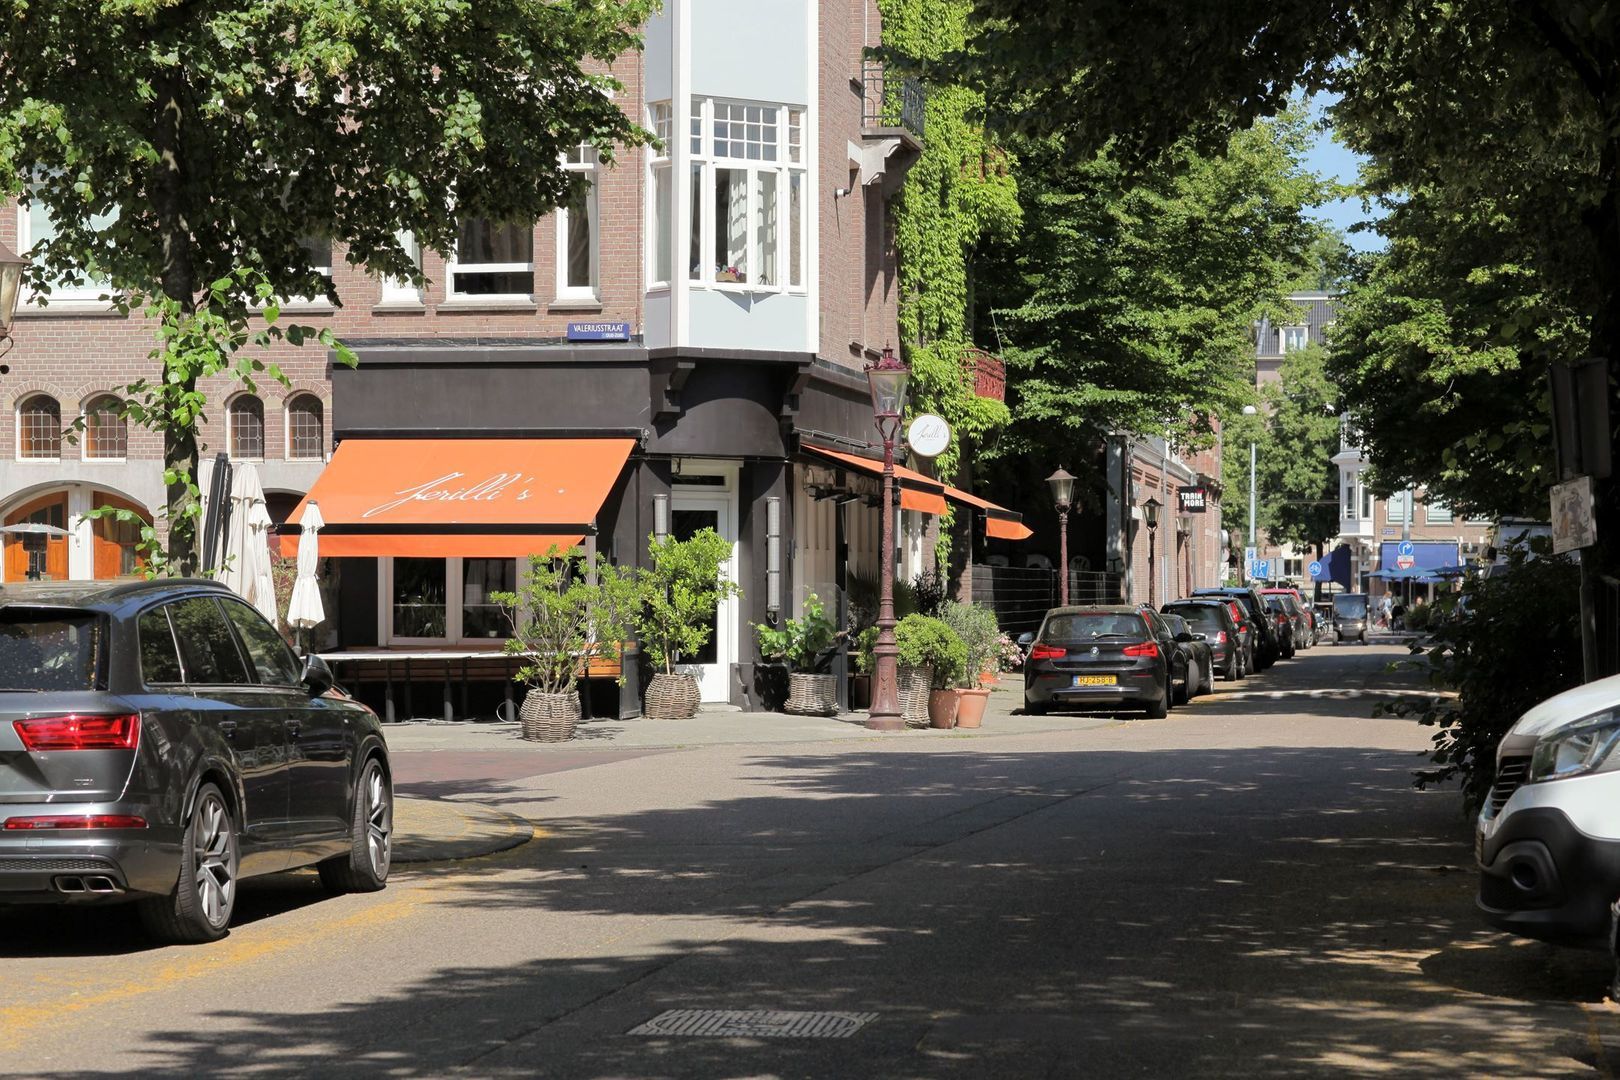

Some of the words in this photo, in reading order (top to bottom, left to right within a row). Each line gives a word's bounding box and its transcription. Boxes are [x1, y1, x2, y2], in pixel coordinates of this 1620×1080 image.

[573, 324, 624, 332] VALERIUSSTRAAT
[1180, 492, 1203, 500] TRAIN
[1184, 499, 1204, 507] MORE
